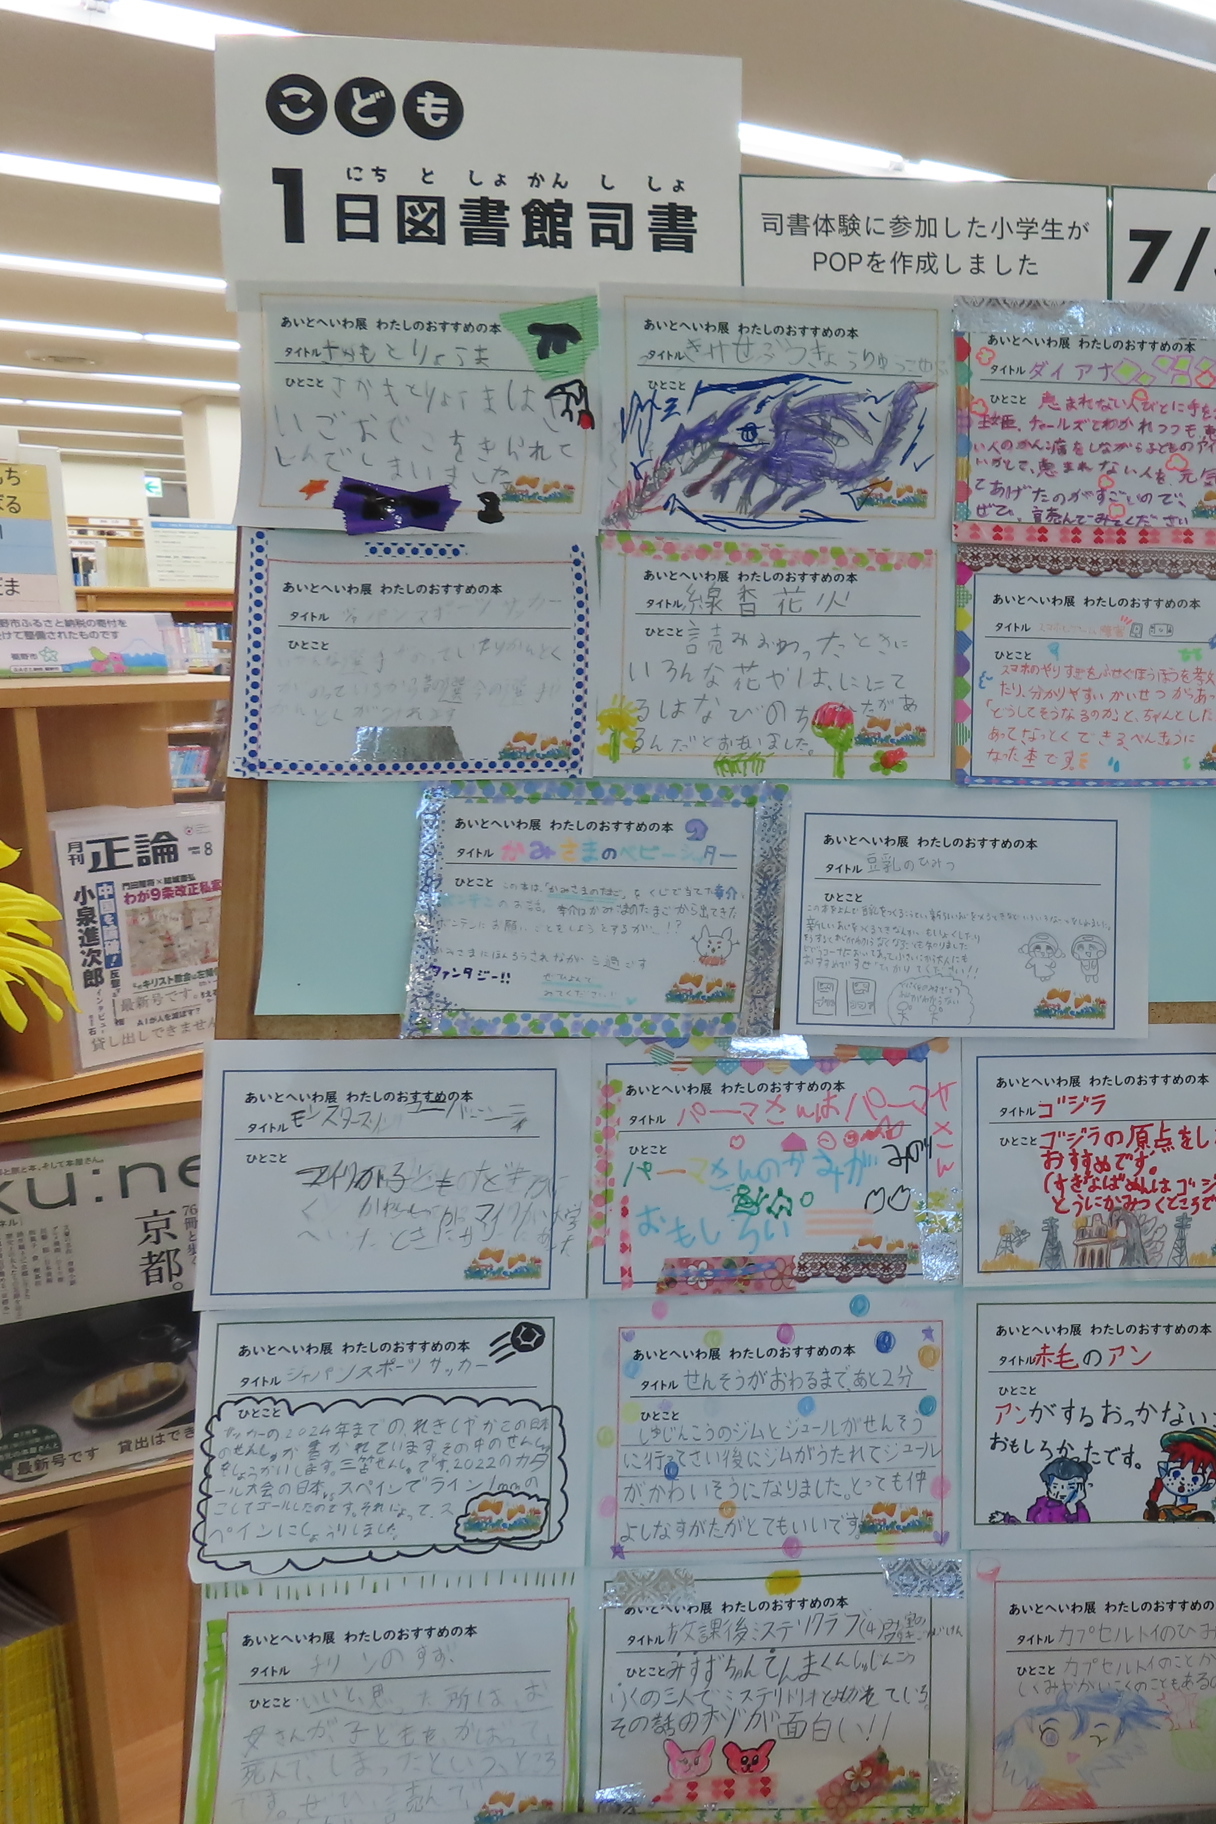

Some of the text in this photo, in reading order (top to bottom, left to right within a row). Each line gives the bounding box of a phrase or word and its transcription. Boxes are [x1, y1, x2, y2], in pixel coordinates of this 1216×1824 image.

[278, 85, 451, 130] こども
[347, 166, 686, 192] にち と しょ かん し しょ
[272, 168, 698, 253] 1日図書館司書
[761, 211, 1090, 241] 司書体験に参加した小学生が
[813, 251, 1038, 277] POPを作成しました
[281, 316, 502, 334] あいとへいわ展 わたしのおすすめの本
[644, 318, 859, 338] あいとへいわ展 わたしのおすすめの本
[988, 336, 1196, 352] あいとへいわ展 わたしのおすすめの本
[285, 347, 321, 358] タイトル
[990, 364, 1026, 375] タイトル
[1030, 361, 1112, 381] ダイアナ
[286, 377, 324, 388] ひとこと
[649, 380, 685, 391] ひとこと
[990, 394, 1027, 404] ひとこと
[0, 466, 21, 486] ち
[0, 495, 21, 514] る
[644, 570, 858, 584] あいとへいわ展 わたしのおすすめの本
[283, 583, 502, 595] あいとへいわ展 わたしのおすすめの本
[646, 599, 682, 609] タイトル
[682, 583, 850, 616] 線香花火
[993, 594, 1201, 609] あいとへいわ展 わたしのおすすめの本
[290, 612, 329, 622] タイトル
[645, 627, 683, 637] ひとこと
[995, 622, 1031, 632] タイトル
[288, 640, 329, 650] ひとこと
[995, 650, 1031, 660] ひとこと
[455, 818, 674, 833] あいとへいわ展 わたしのおすすめの本
[823, 835, 1038, 850] あいとへいわ展 わたしのおすすめの本
[68, 841, 85, 865] 月刊
[86, 831, 179, 873] 正論
[457, 848, 493, 858] タイトル
[825, 864, 862, 873] タイトル
[867, 853, 955, 873] 豆乳のひみつ
[455, 877, 493, 887] ひとこと
[825, 892, 862, 902] ひとこと
[74, 885, 105, 990] 小泉進次郎
[996, 1074, 1209, 1088] あいとへいわ展 わたしのおすすめの本
[626, 1080, 845, 1096] あいとへいわ展 わたしのおすすめの本
[245, 1091, 473, 1103] あいとへいわ展 わたしのおすすめの本
[1038, 1094, 1106, 1118] ゴジラ
[1000, 1107, 1035, 1117] タイトル
[629, 1115, 666, 1125] タイトル
[248, 1122, 288, 1133] タイトル
[1000, 1136, 1037, 1146] ひとこと
[629, 1144, 666, 1154] ひとこと
[246, 1153, 287, 1163] ひとこと
[135, 1209, 184, 1291] 京都。
[996, 1324, 1212, 1336] あいとへいわ展 わたしのおすすめの本
[238, 1340, 470, 1357] あいとへいわ展 わたしのおすすめの本
[633, 1344, 856, 1361] あいとへいわ展 わたしのおすすめの本
[999, 1355, 1036, 1366] タイトル
[1035, 1343, 1152, 1370] 赤毛のアン
[240, 1376, 280, 1387] タイトル
[641, 1379, 678, 1390] タイトル
[999, 1386, 1036, 1396] ひとこと
[238, 1407, 280, 1418] ひとこと
[641, 1411, 679, 1421] ひとこと
[990, 1432, 1142, 1471] おもしろかったです。
[16, 1446, 100, 1477] 最新号です
[625, 1597, 848, 1614] あいとへいわ展 わたしのおすすめの本
[1009, 1604, 1096, 1615] あいとへいわ展
[242, 1625, 477, 1647] あいとへいわ展 わたしのおすすめの本
[627, 1635, 664, 1645] タイトル
[1017, 1634, 1054, 1645] タイトル
[250, 1667, 290, 1677] タイトル
[626, 1667, 665, 1677] ひとこと
[1017, 1665, 1055, 1676] ひとこと
[250, 1698, 290, 1709] ひとこと
